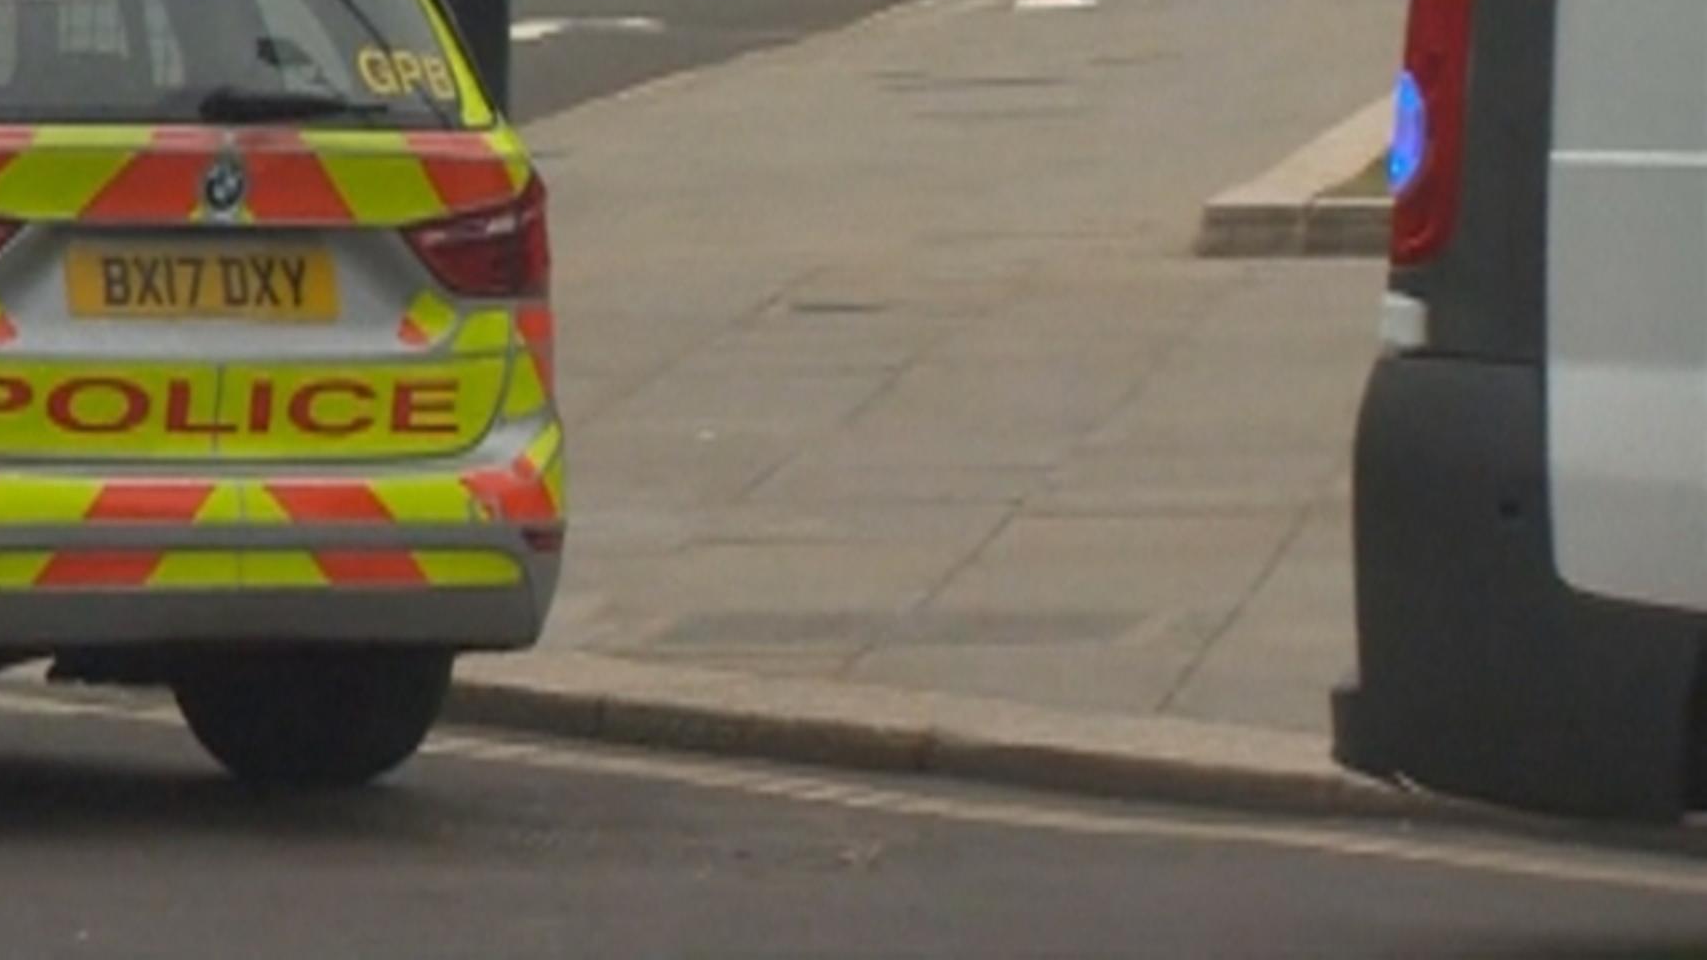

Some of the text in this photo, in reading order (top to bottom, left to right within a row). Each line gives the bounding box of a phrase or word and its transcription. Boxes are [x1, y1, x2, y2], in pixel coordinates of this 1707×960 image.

[358, 47, 455, 99] GPB
[102, 254, 306, 307] BX17 DXY
